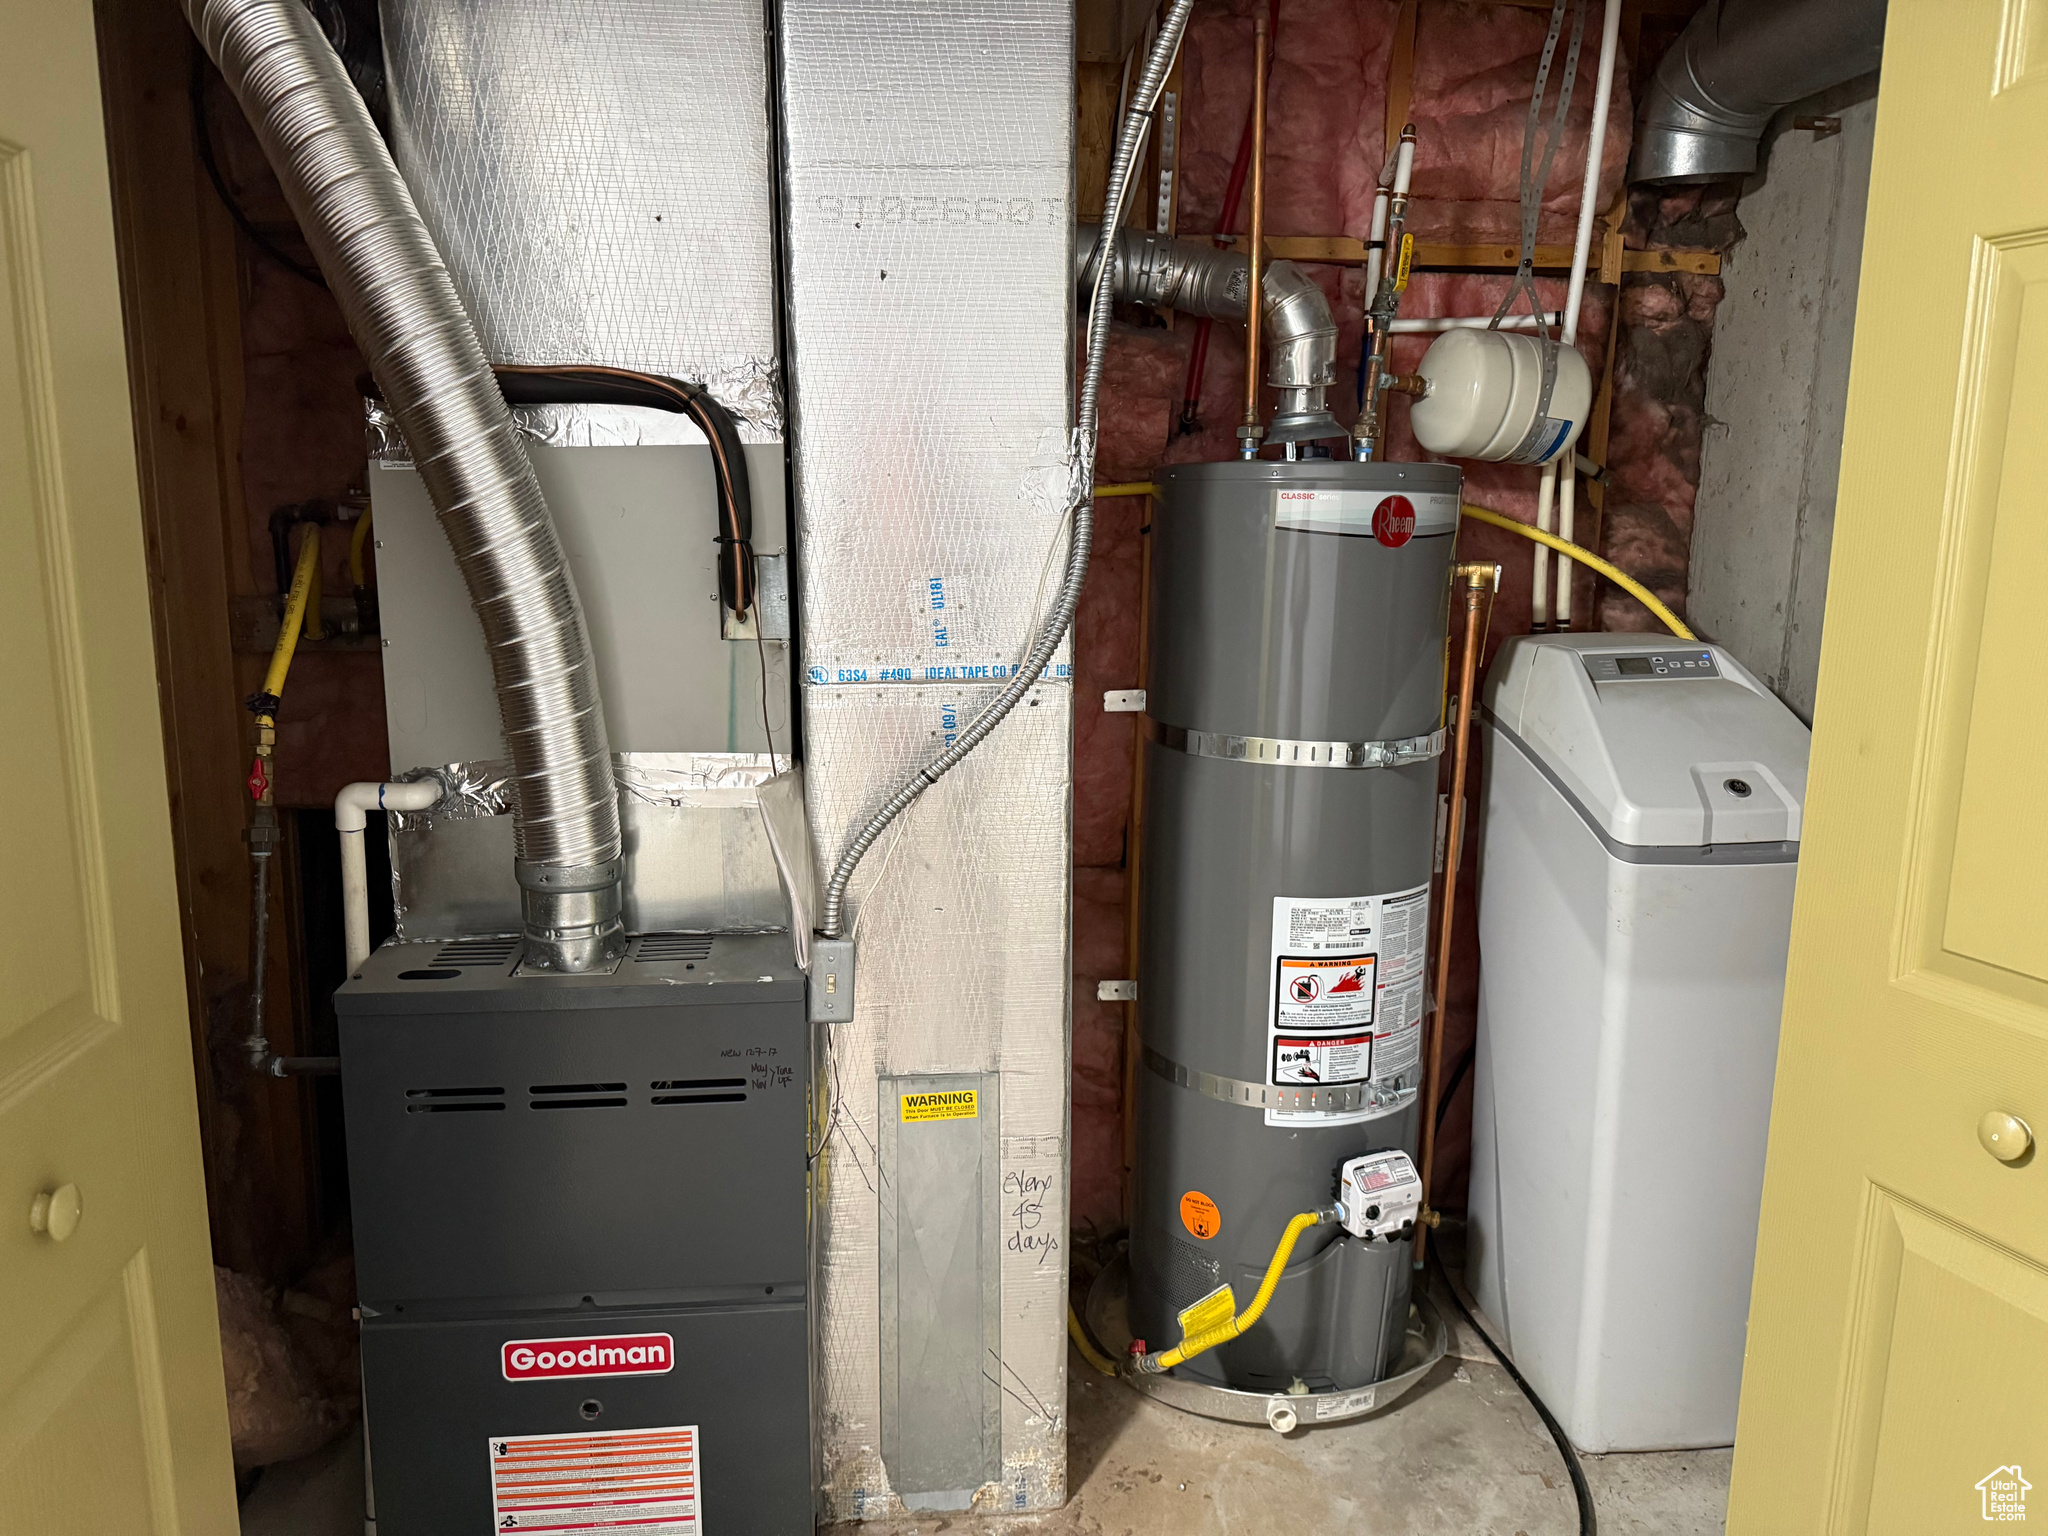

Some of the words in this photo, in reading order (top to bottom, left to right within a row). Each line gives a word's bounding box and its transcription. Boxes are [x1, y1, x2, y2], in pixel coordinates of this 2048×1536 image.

[1377, 498, 1414, 540] Rheem
[838, 668, 867, 682] 63S4
[879, 667, 911, 681] #490
[925, 666, 959, 680] IDEAL
[962, 665, 990, 679] TAPE
[992, 665, 1006, 678] CO
[751, 1063, 768, 1077] May
[906, 1092, 974, 1107] WARNING
[1012, 1199, 1043, 1230] 45
[1008, 1230, 1058, 1265] days
[510, 1344, 665, 1371] Goodman
